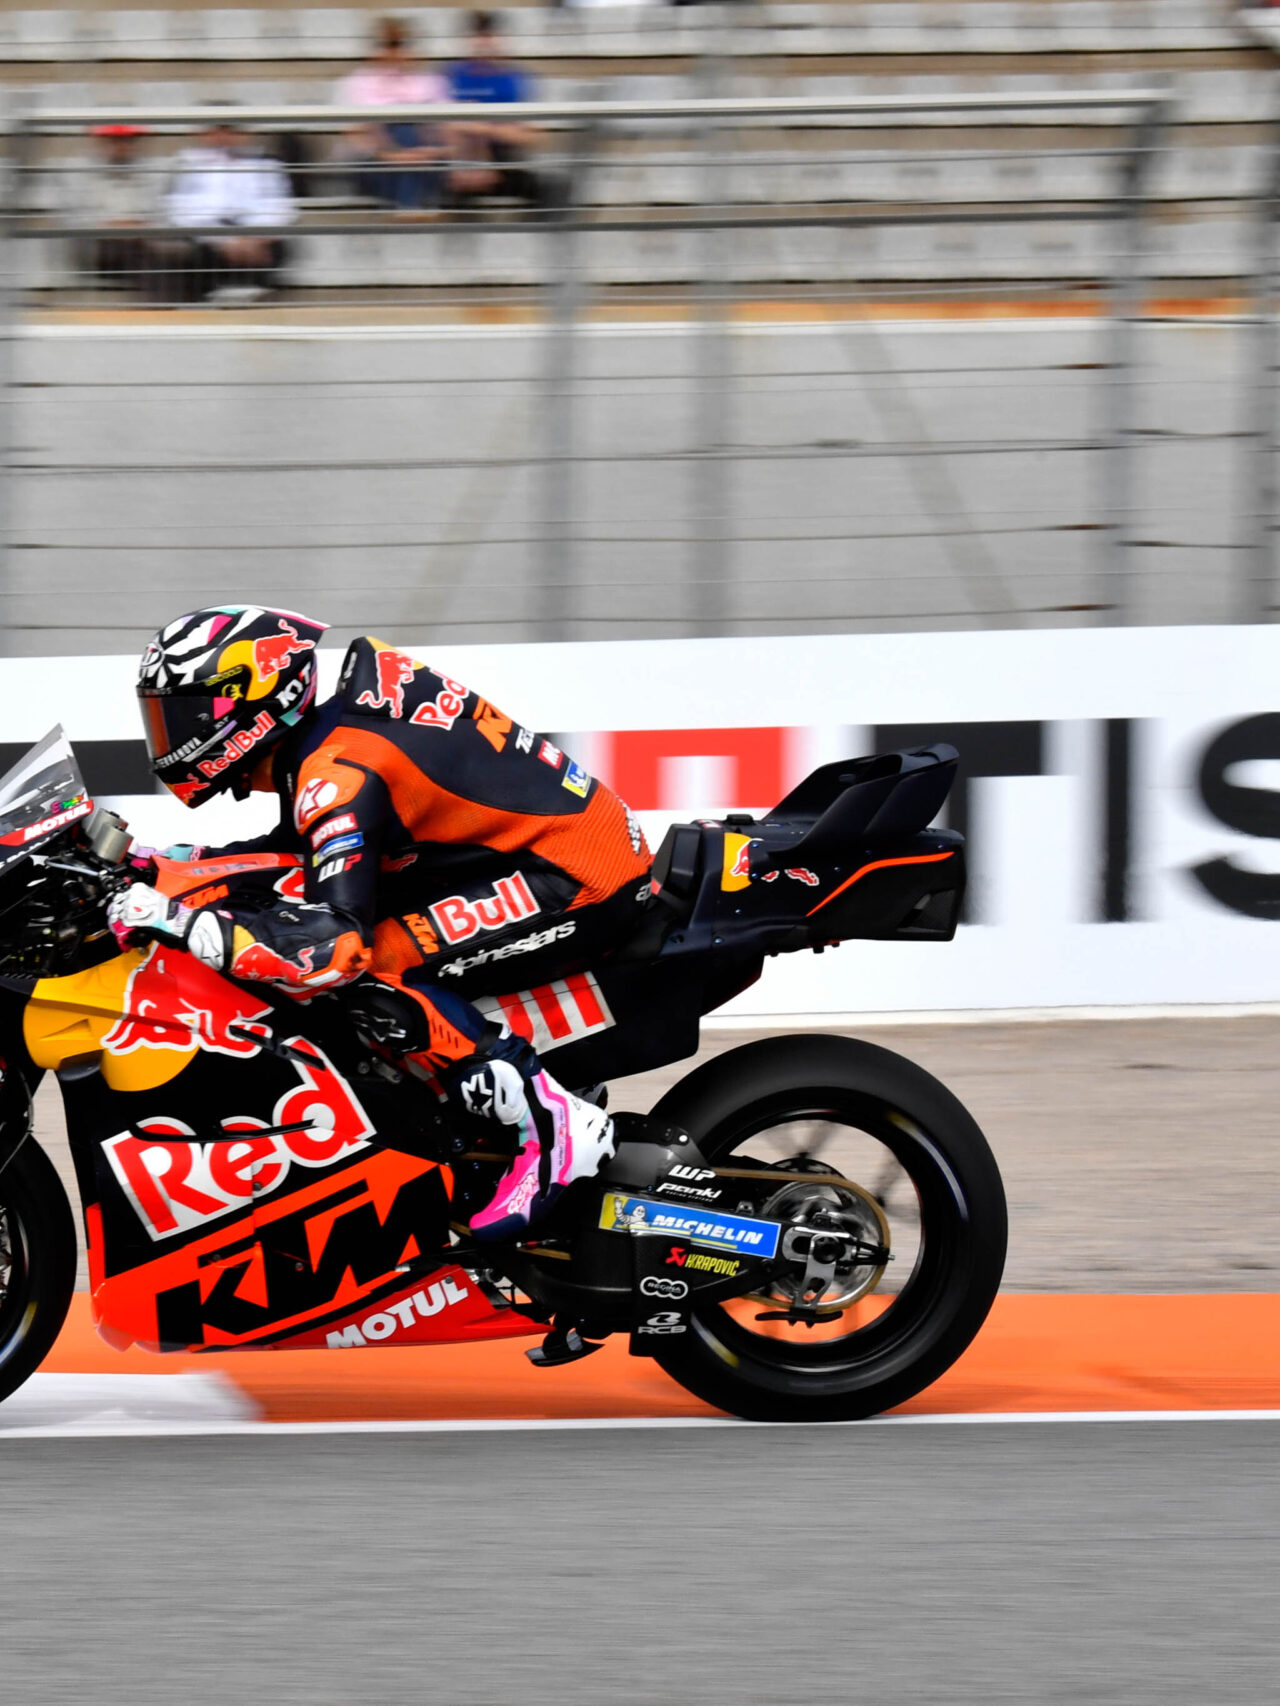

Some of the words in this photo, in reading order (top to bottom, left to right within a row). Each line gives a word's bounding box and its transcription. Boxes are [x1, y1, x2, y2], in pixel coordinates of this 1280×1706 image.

[275, 662, 313, 709] KYT
[409, 667, 470, 731] Red
[196, 739, 245, 778] Red
[233, 710, 276, 754] Bull
[24, 803, 91, 841] MOTUL
[312, 816, 356, 849] MOTUL
[402, 912, 440, 955] KTM
[427, 870, 541, 945] Bull
[437, 920, 577, 978] alpinestars
[101, 1035, 377, 1242] Red
[668, 1164, 717, 1181] WP
[652, 1214, 764, 1245] MICHELIN
[155, 1167, 452, 1353] KTM
[326, 1278, 469, 1349] MOTUL
